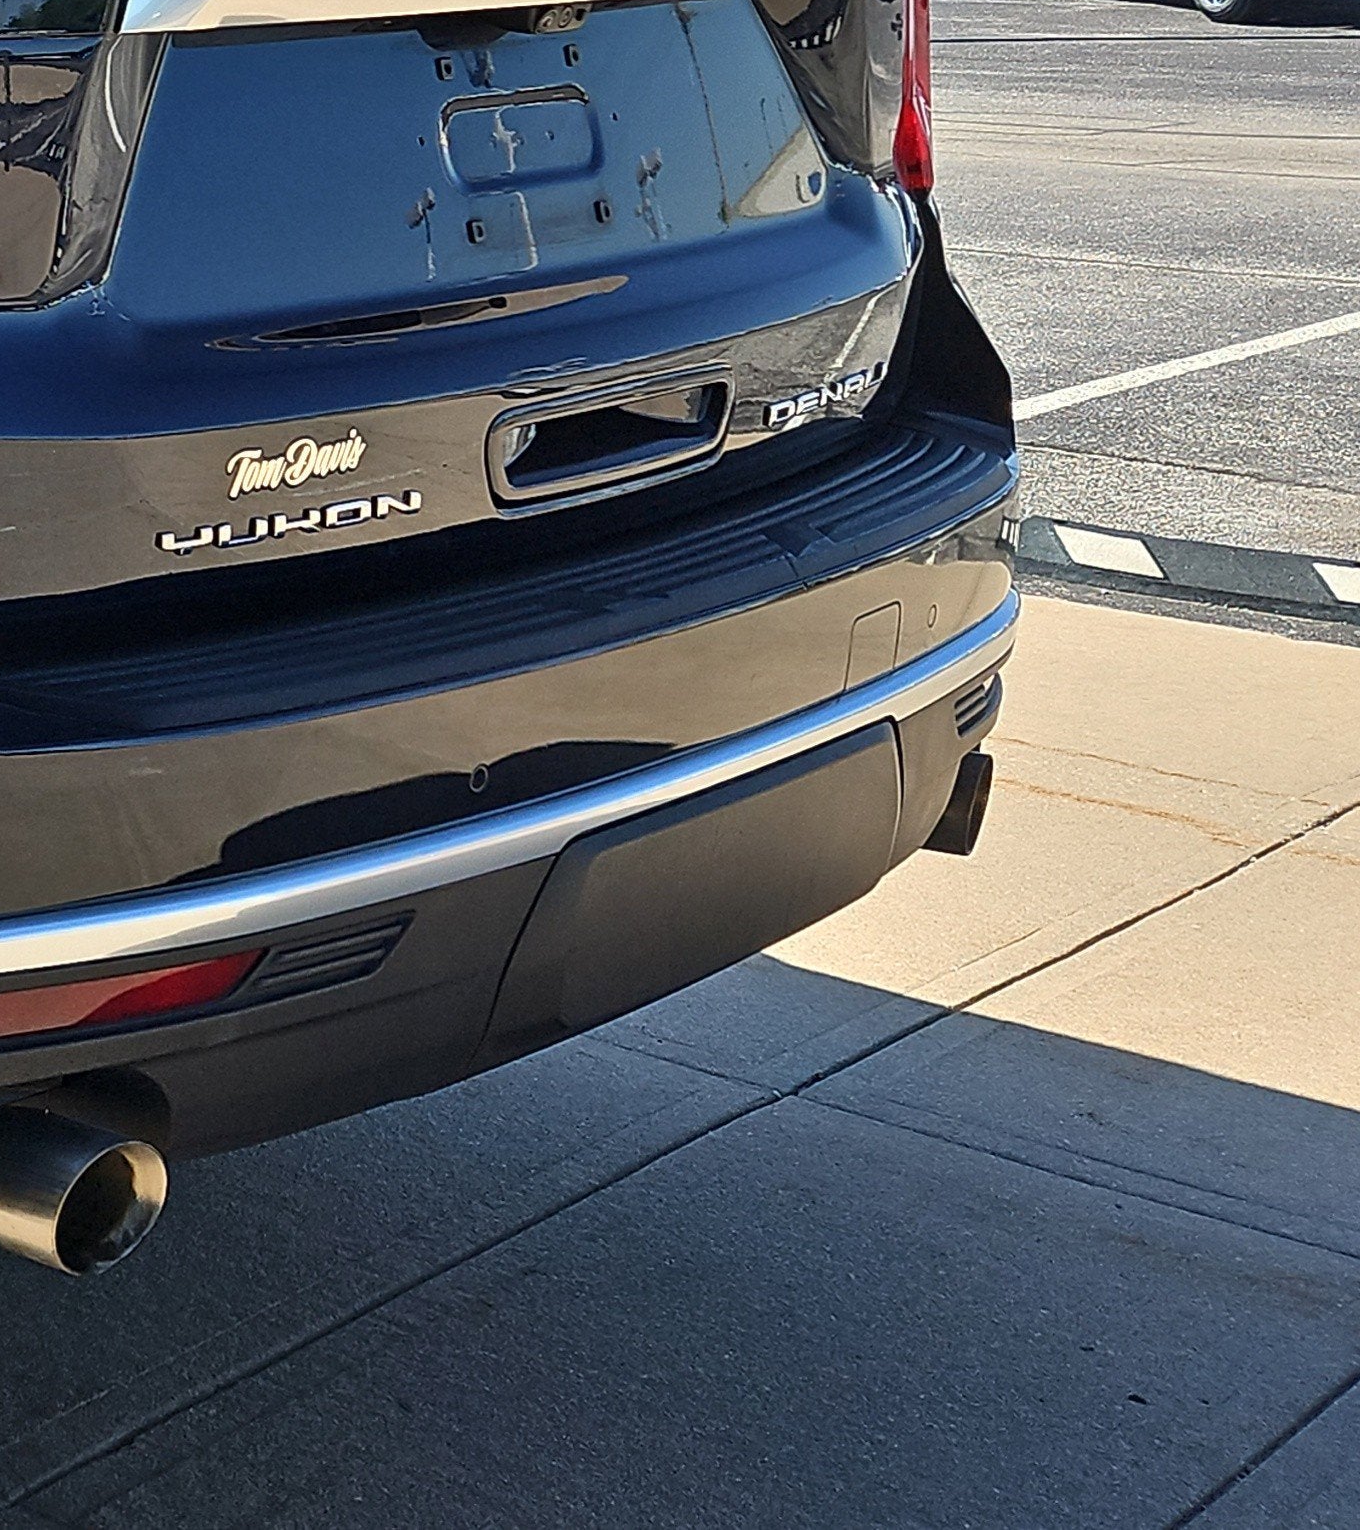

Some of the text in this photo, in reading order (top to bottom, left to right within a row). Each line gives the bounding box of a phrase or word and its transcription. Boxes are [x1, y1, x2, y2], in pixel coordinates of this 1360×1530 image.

[763, 361, 888, 429] DENALI
[225, 426, 368, 501] Tom Davis
[155, 489, 423, 556] YUKON
